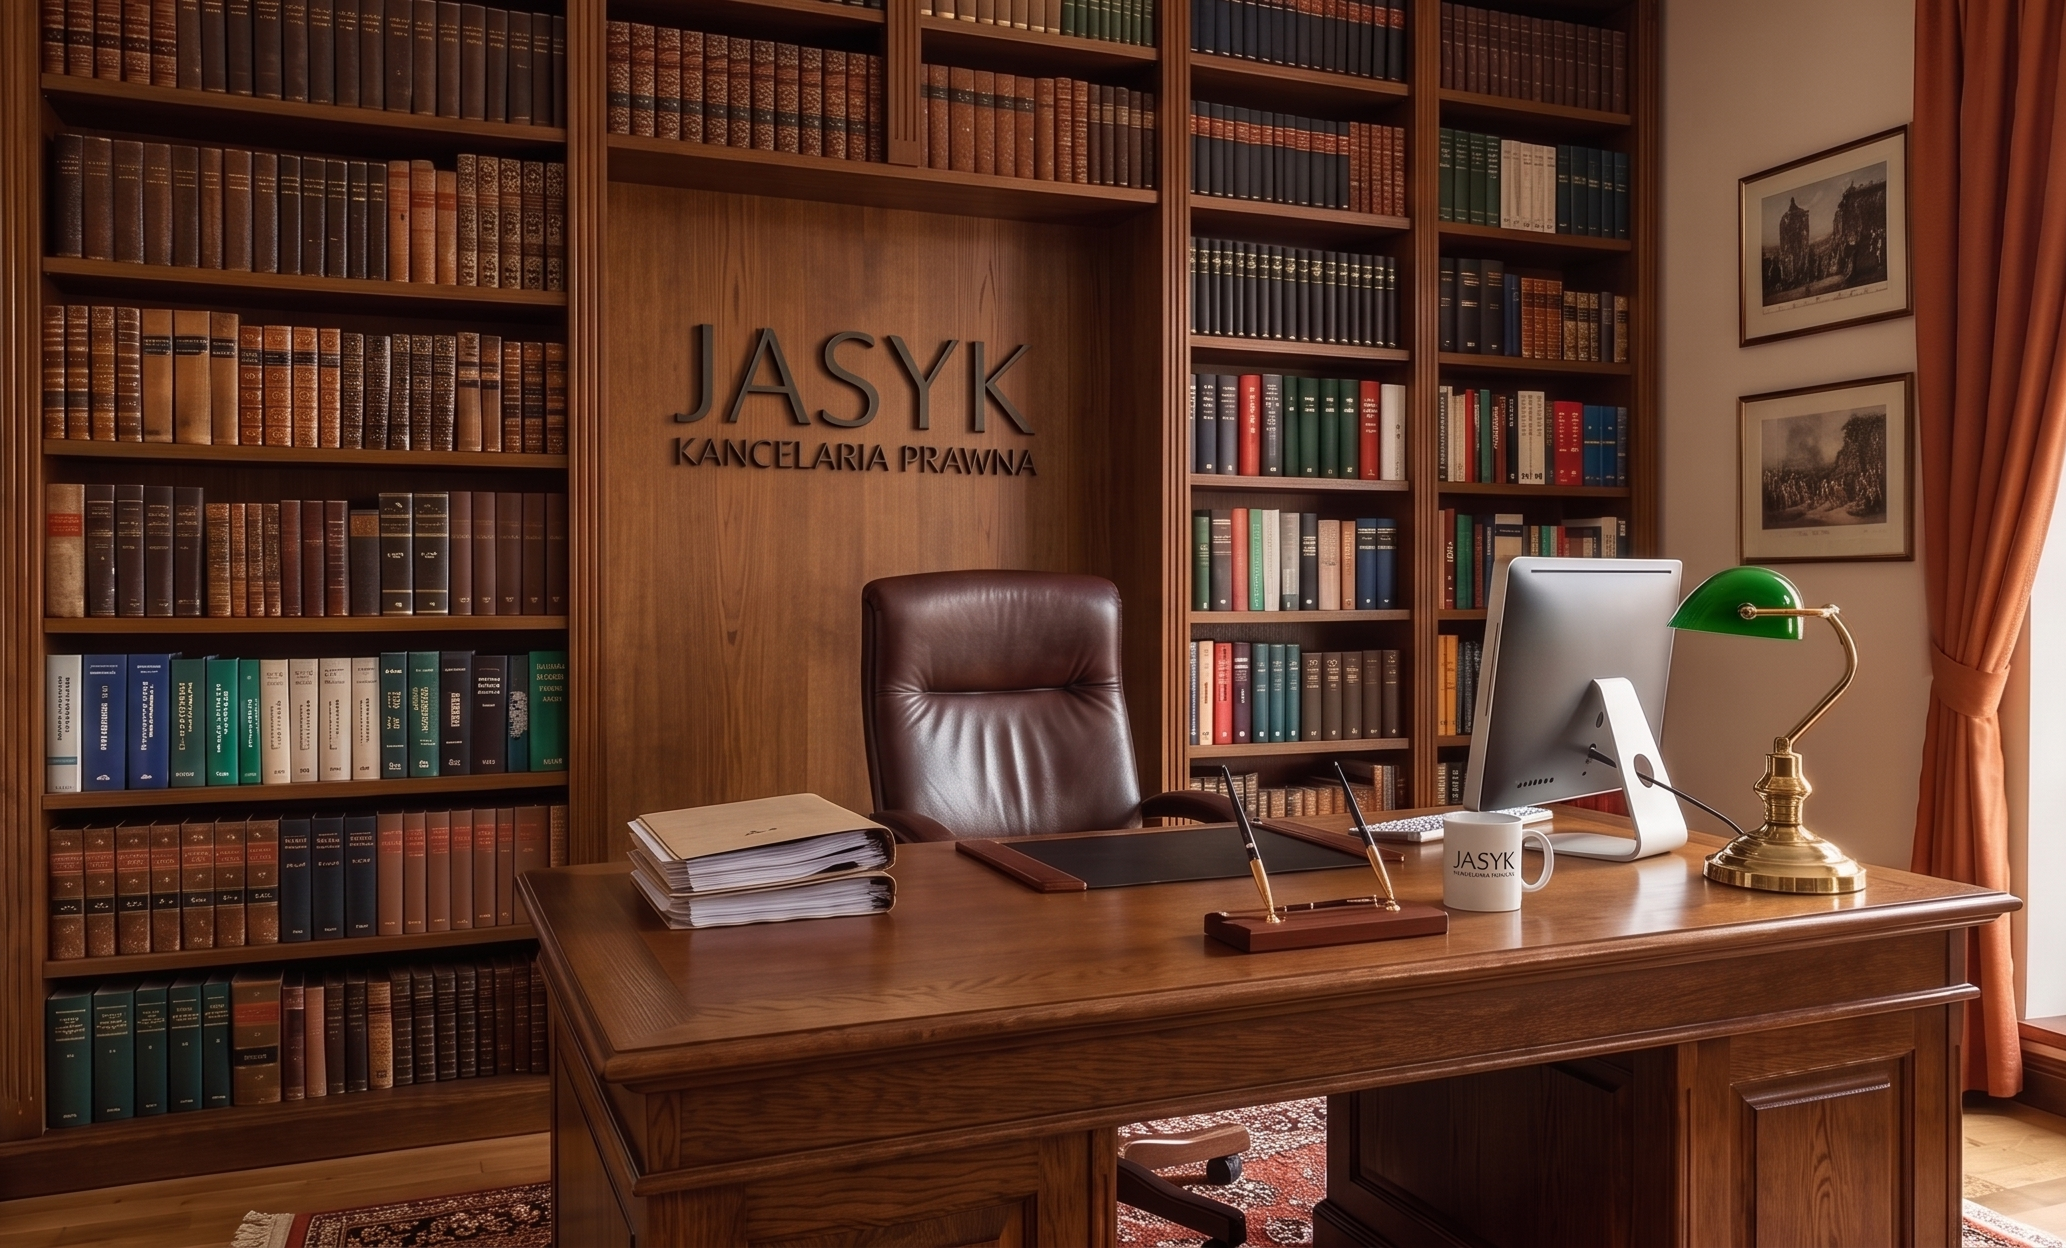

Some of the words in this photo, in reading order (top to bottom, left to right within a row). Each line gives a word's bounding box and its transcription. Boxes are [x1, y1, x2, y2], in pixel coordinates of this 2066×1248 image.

[674, 323, 1035, 436] JASYK
[674, 437, 889, 472] KANCELARIA
[901, 444, 1038, 477] PRAWNA
[1453, 850, 1515, 870] JASYK
